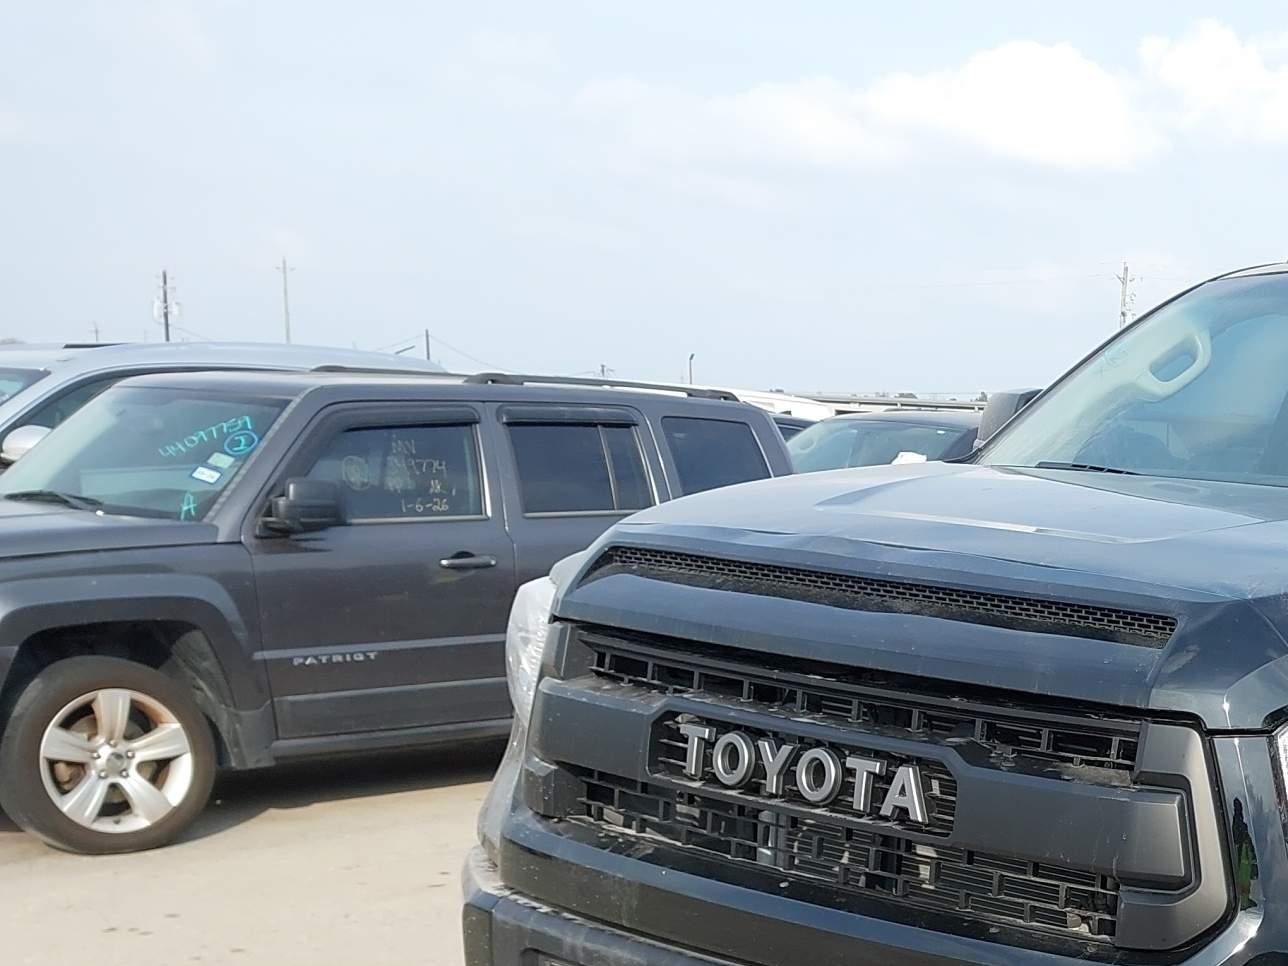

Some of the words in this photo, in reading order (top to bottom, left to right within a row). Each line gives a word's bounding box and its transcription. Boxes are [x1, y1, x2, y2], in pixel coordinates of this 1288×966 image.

[179, 491, 198, 521] A
[292, 651, 379, 666] PATRIOT
[679, 724, 929, 824] TOYOTA
